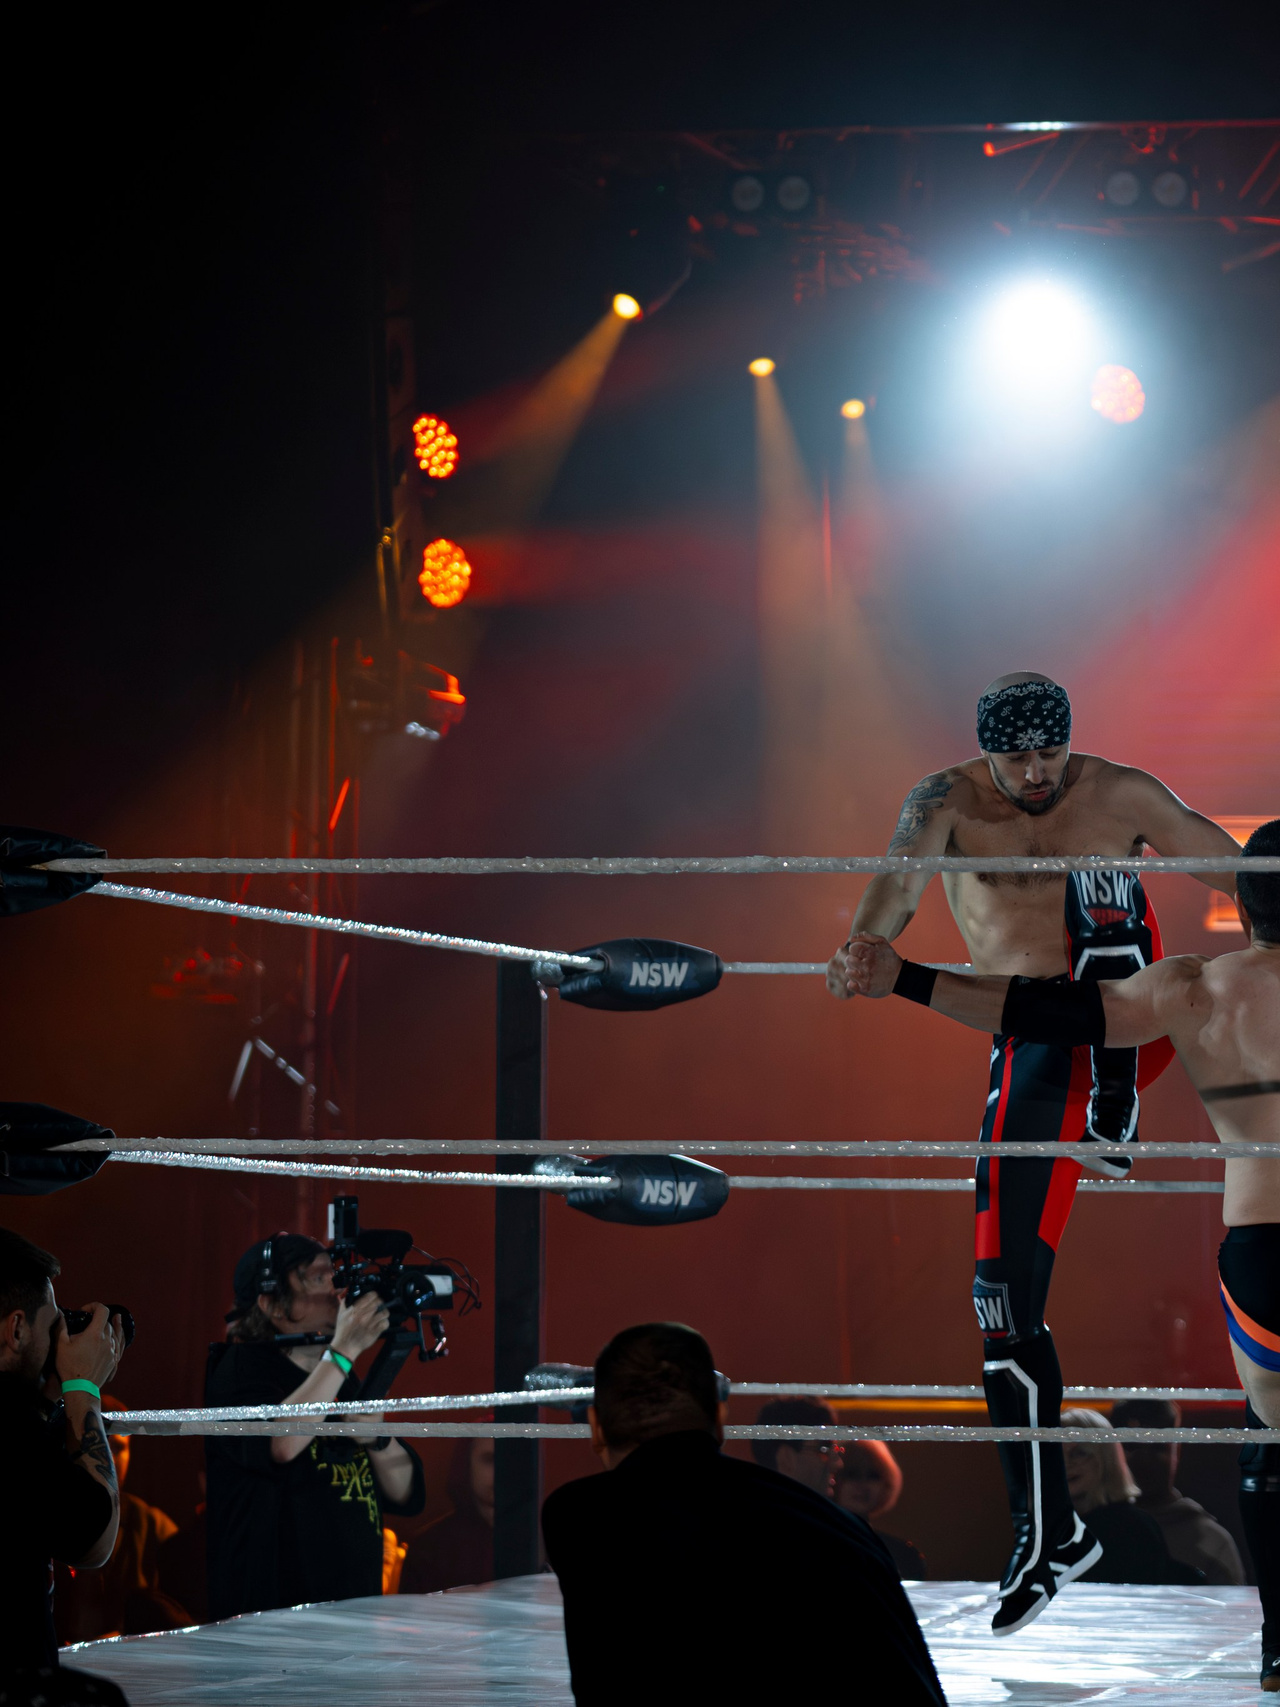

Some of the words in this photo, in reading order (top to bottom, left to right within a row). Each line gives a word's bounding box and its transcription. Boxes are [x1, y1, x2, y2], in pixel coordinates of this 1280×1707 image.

[1080, 870, 1130, 909] NSW
[629, 961, 690, 988] NSW
[640, 1178, 698, 1206] NSW
